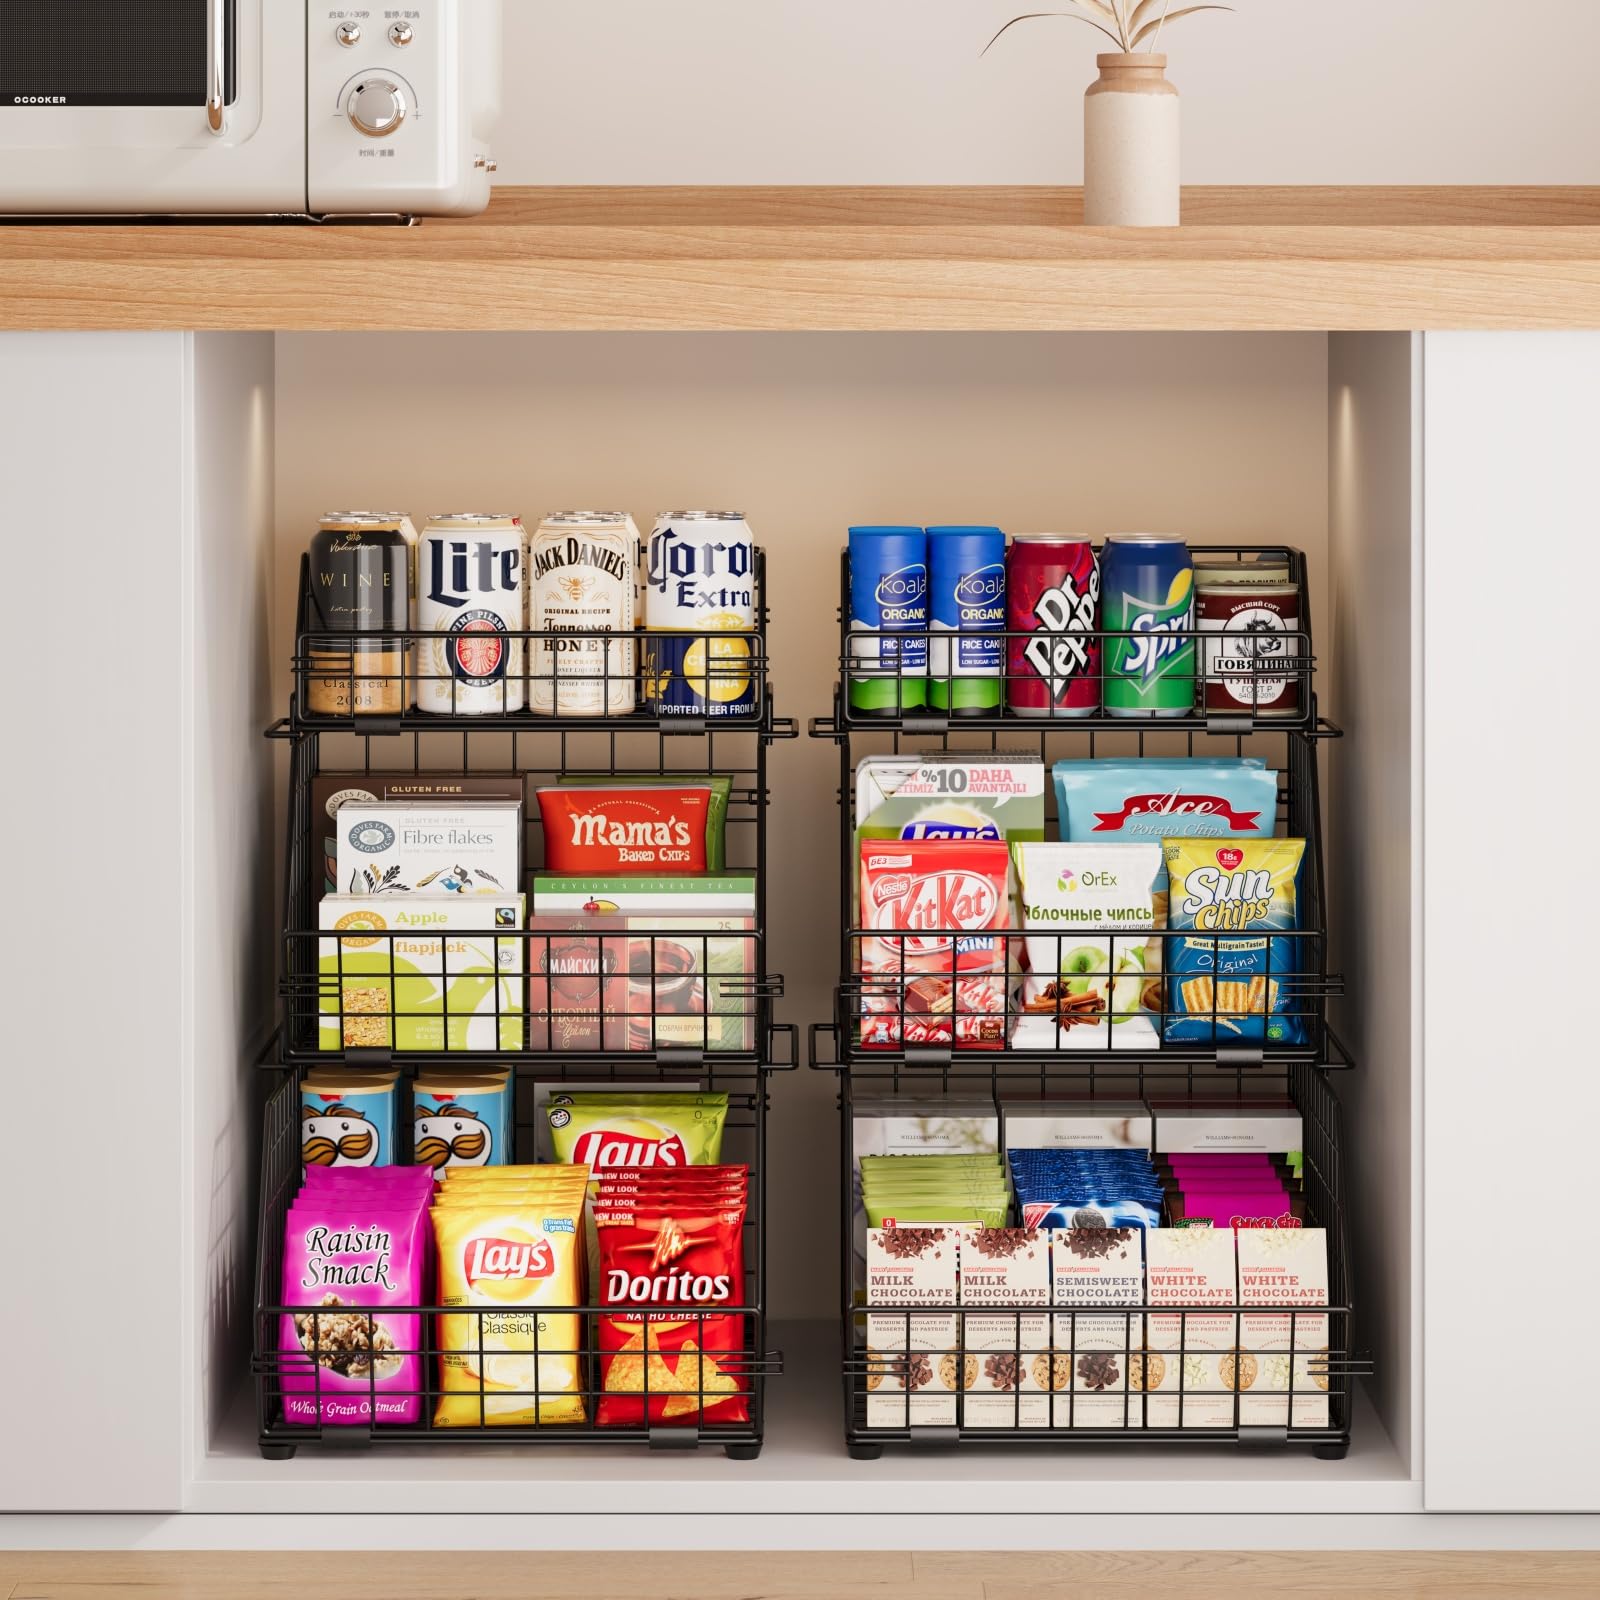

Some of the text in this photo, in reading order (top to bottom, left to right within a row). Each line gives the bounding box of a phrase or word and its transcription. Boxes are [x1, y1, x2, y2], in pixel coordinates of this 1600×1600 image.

[14, 96, 66, 104] OCOOKER
[534, 537, 627, 581] JACK DANIEL'S
[320, 572, 391, 587] WINE
[426, 538, 519, 608] Lite
[880, 576, 926, 594] koala
[960, 576, 1005, 594] koala
[676, 580, 751, 608] Extra
[1230, 600, 1281, 613] ВЫСШИЙ СОРТ
[477, 611, 506, 631] PILSN
[905, 639, 926, 649] CAKES
[961, 639, 1005, 649] RICE CAK
[1217, 659, 1293, 670] ГОВЯДИНА
[336, 696, 372, 706] 2008
[969, 769, 1013, 782] DAHA
[968, 783, 1027, 794] AVANTAJLI
[356, 790, 374, 802] FAR
[1131, 787, 1224, 817] Ace
[350, 822, 374, 839] DOVES
[403, 829, 494, 844] Fibre flakes
[568, 813, 692, 846] Mama's
[1128, 822, 1225, 838] Potato Chips
[353, 839, 392, 852] ORGANIC
[1081, 871, 1117, 886] OrEx
[1182, 866, 1275, 916] Sun
[394, 911, 449, 925] Apple
[1107, 907, 1155, 920] чипсы
[1193, 898, 1270, 931] Chips
[394, 941, 469, 956] flapjack
[953, 936, 994, 954] MINI
[1192, 940, 1210, 949] Great
[1245, 940, 1265, 949] Taste!
[1196, 953, 1259, 974] Original
[684, 1024, 713, 1032] ВРУЧНЮ
[612, 1212, 633, 1220] LOOK
[306, 1225, 390, 1258] Raisin
[470, 1239, 548, 1280] Lay's
[302, 1252, 396, 1291] Smack
[607, 1266, 730, 1302] Doritos
[871, 1275, 914, 1286] MILK
[964, 1275, 1007, 1286] MILK
[1056, 1277, 1138, 1286] SEMISWEET
[1151, 1275, 1207, 1286] WHITE
[1243, 1275, 1299, 1286] WHITE
[871, 1288, 952, 1297] CHOCOLATE
[964, 1288, 1046, 1297] CHOCOLATE
[1056, 1288, 1138, 1297] CHOCOLATE
[1151, 1288, 1233, 1297] CHOCOLATE
[1243, 1288, 1325, 1297] CHOCOLATE
[480, 1320, 547, 1336] Classique
[326, 1401, 357, 1418] Grain
